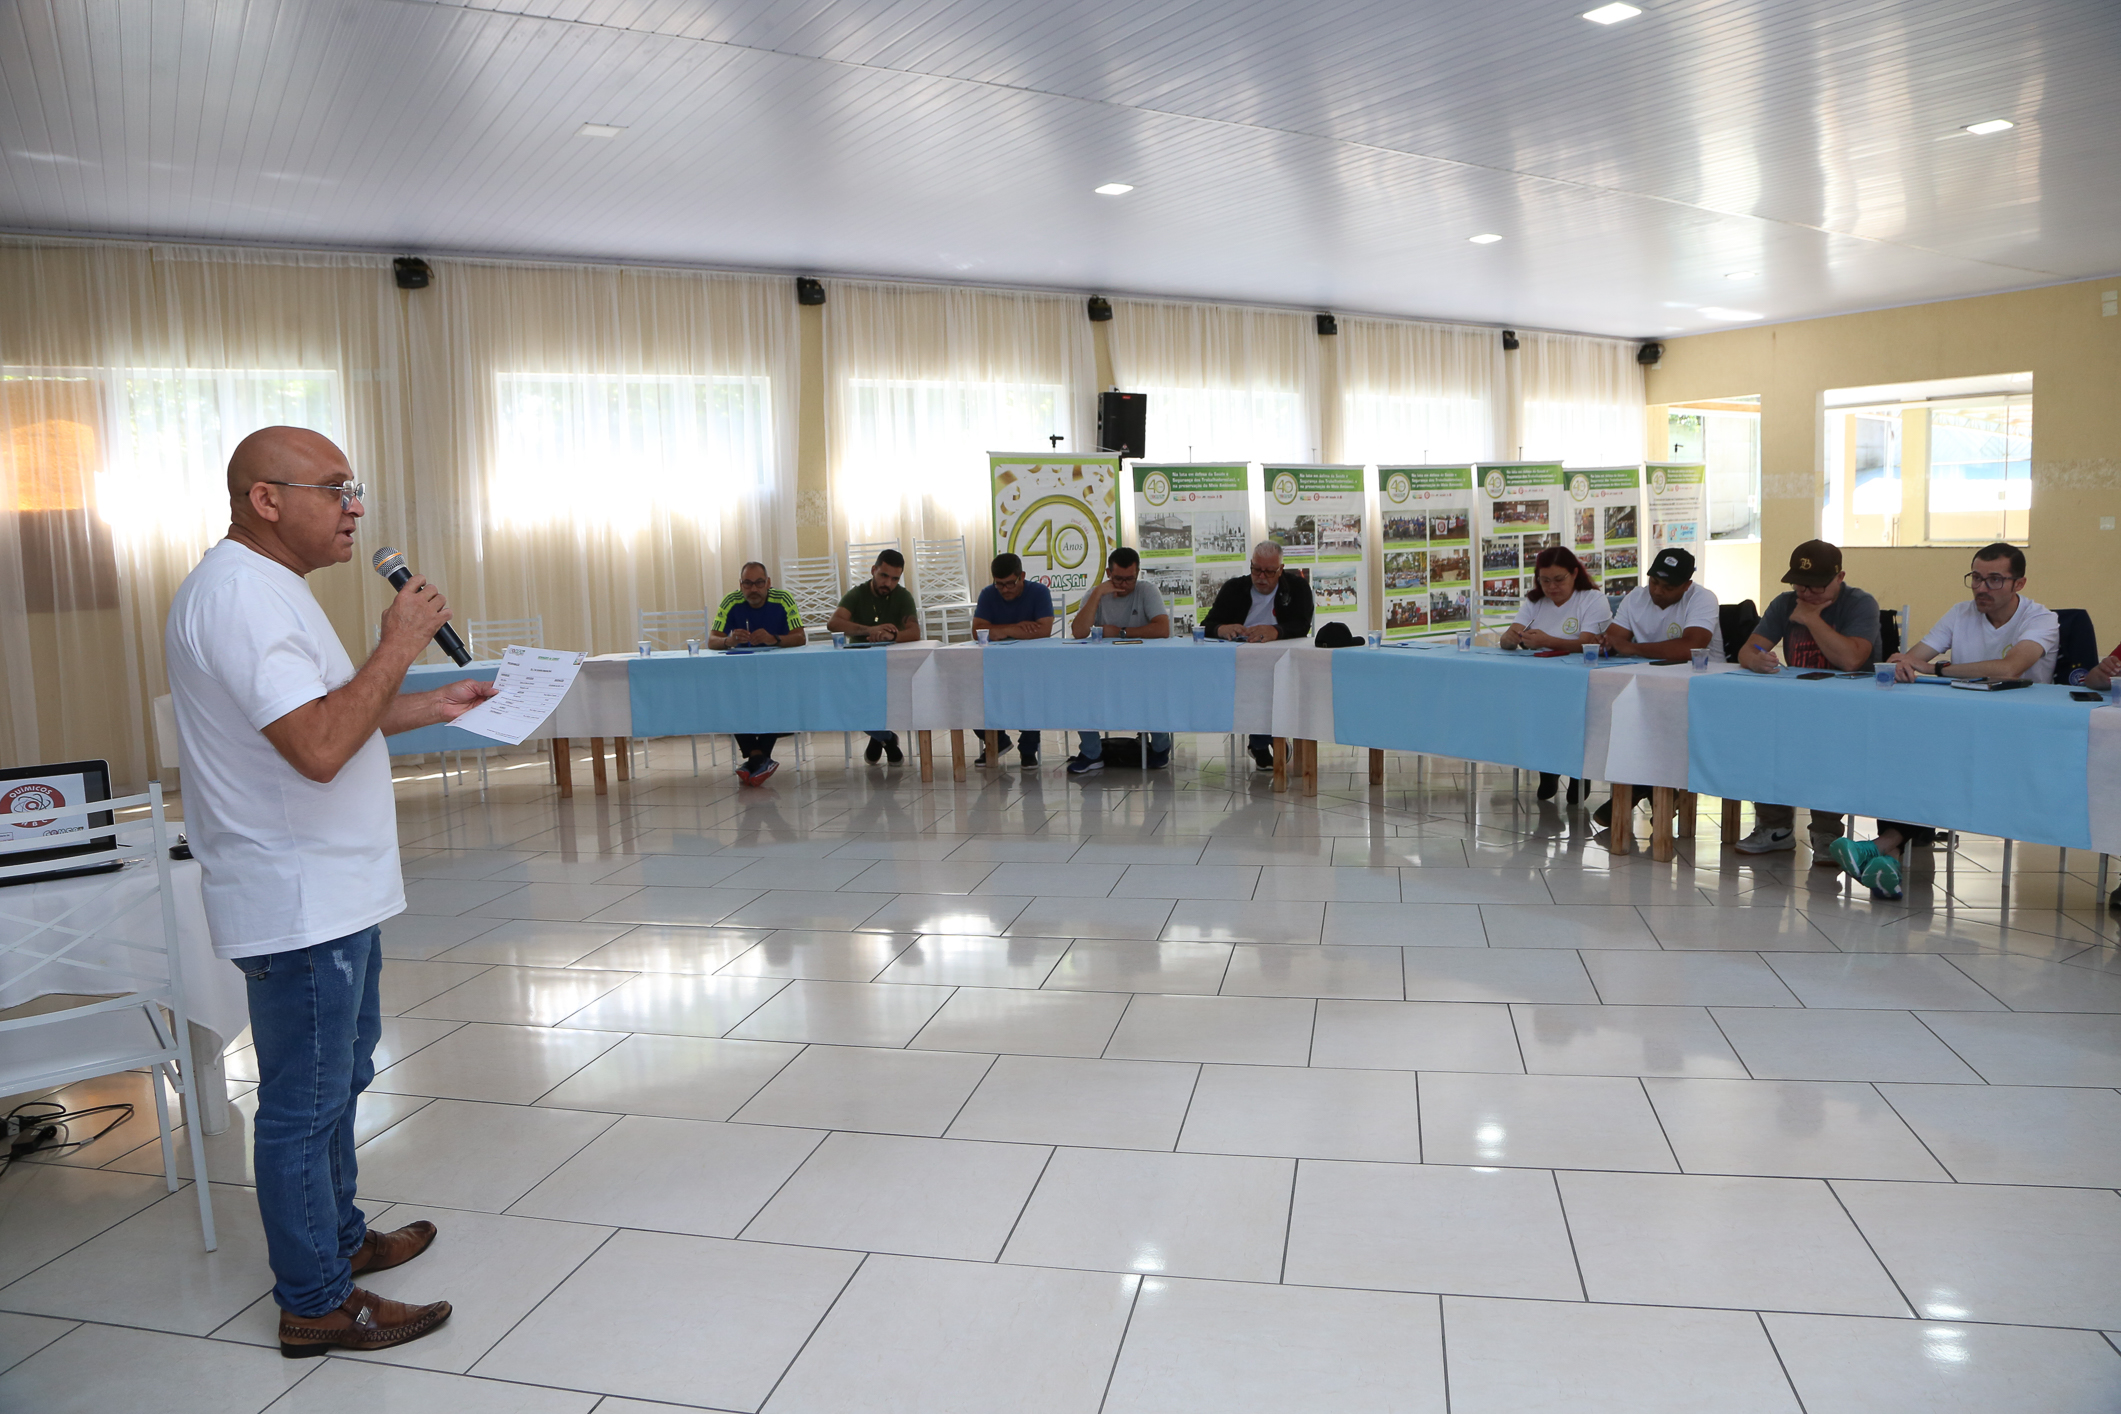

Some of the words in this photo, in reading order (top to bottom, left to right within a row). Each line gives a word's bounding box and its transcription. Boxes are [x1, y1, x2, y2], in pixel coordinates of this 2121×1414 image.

[1022, 519, 1088, 570] 40
[1062, 542, 1083, 551] Anos
[1799, 557, 1812, 570] B
[9, 786, 52, 798] QUÍMICOS
